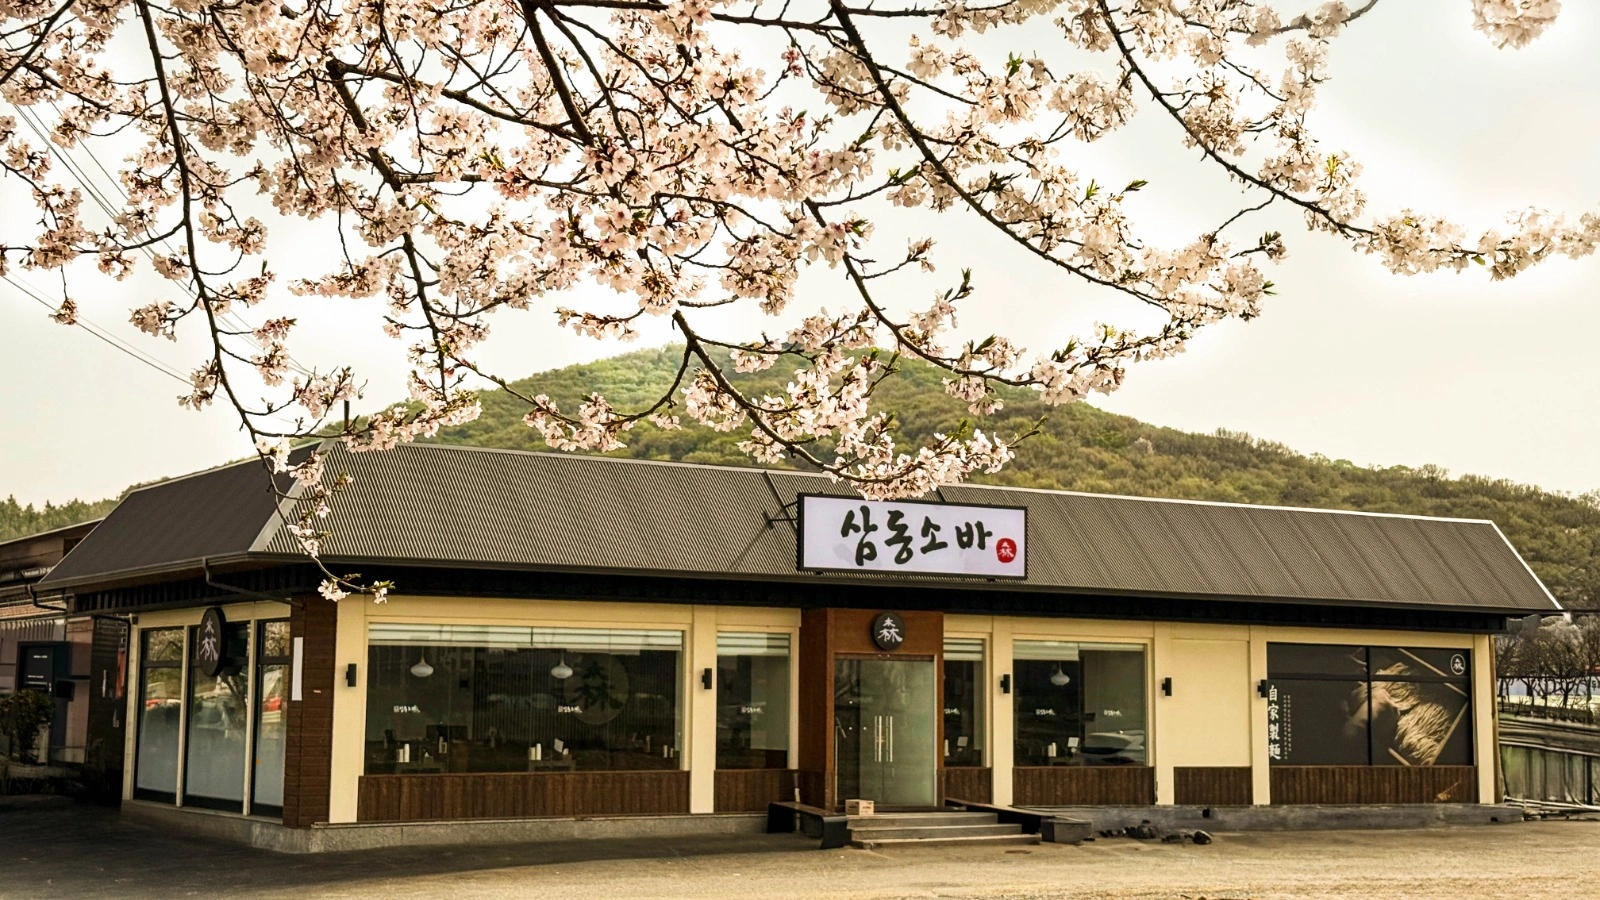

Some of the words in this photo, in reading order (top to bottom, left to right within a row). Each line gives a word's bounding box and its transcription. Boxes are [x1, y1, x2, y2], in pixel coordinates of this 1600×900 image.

[841, 505, 993, 566] 삼동소바
[998, 540, 1015, 559] 森
[199, 616, 219, 662] 森
[877, 616, 903, 643] 森
